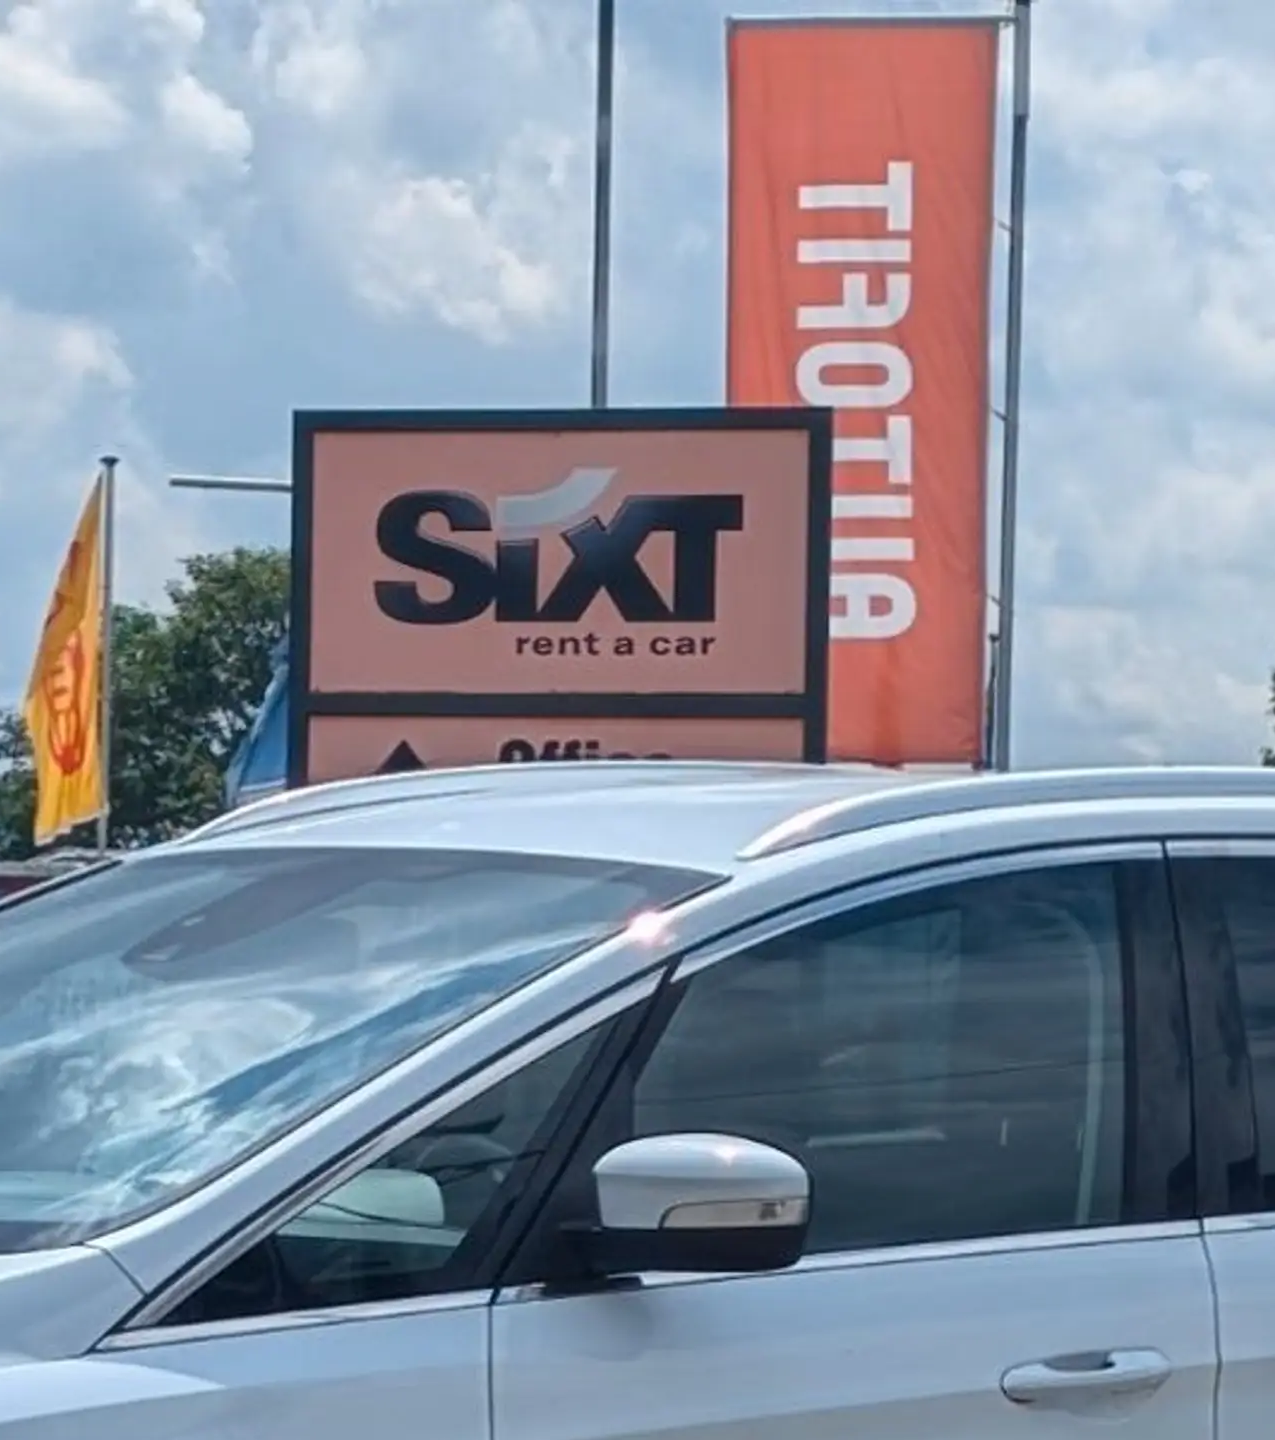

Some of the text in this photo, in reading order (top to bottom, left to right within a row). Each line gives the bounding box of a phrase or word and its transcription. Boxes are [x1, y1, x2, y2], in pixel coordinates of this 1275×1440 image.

[515, 631, 715, 656] rent a car
[497, 738, 672, 760] Offi
